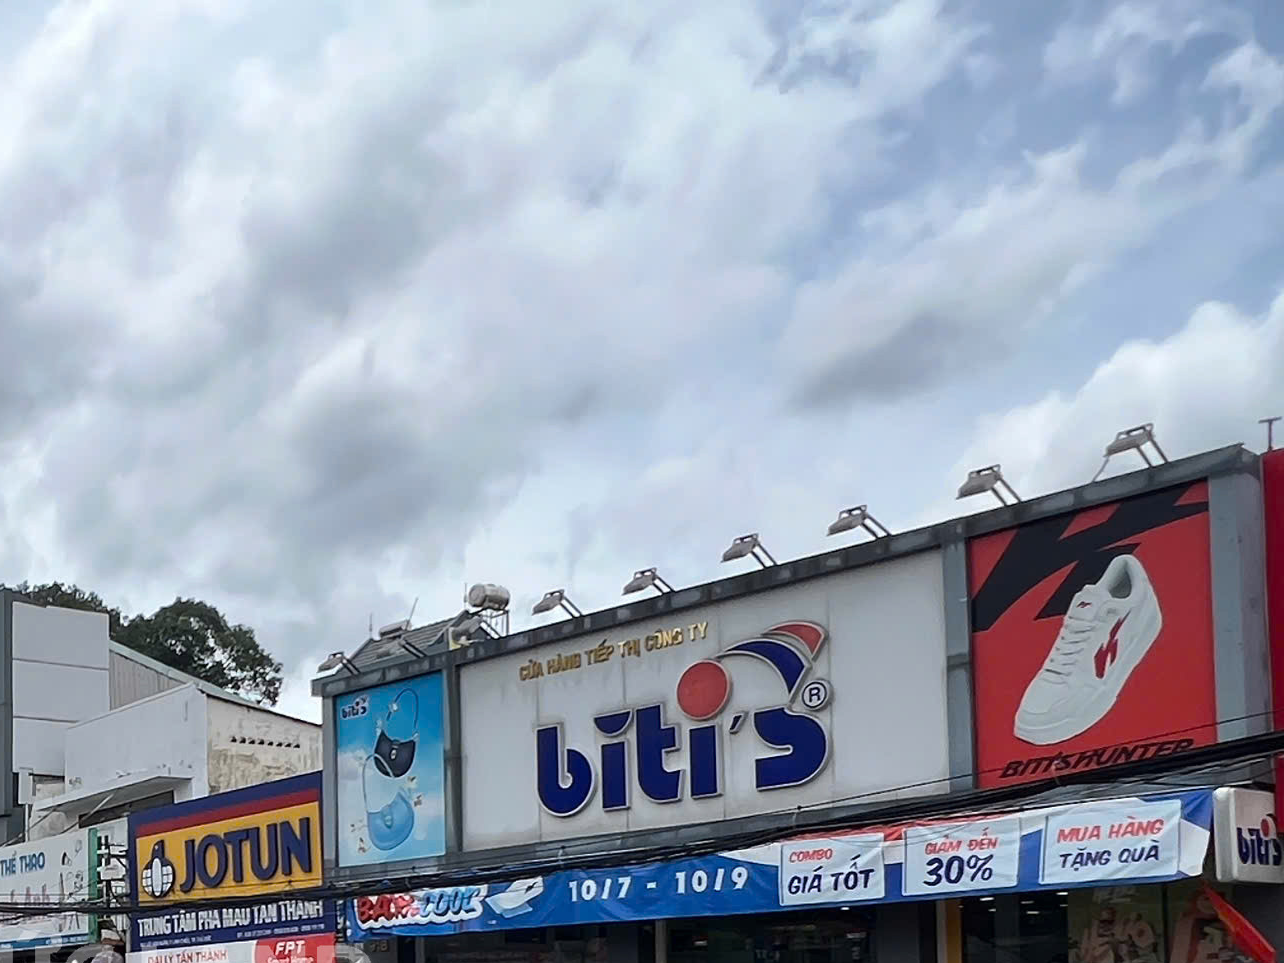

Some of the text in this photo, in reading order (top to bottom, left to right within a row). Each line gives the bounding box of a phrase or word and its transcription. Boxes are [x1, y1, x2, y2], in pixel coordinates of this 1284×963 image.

[644, 628, 684, 652] CÔNG
[688, 622, 709, 642] TY
[535, 648, 829, 818] biti's
[1056, 815, 1165, 843] MUA HÀNG
[180, 816, 313, 893] JOTUN
[789, 848, 833, 863] COMBO
[923, 854, 994, 887] 30%
[1059, 839, 1160, 871] TẶNG QUÀ
[569, 876, 632, 902] 10/7
[675, 866, 749, 895] 10/9
[787, 854, 875, 895] GIÁ TỐT
[137, 914, 172, 937] TRUNG
[275, 940, 306, 957] FPT
